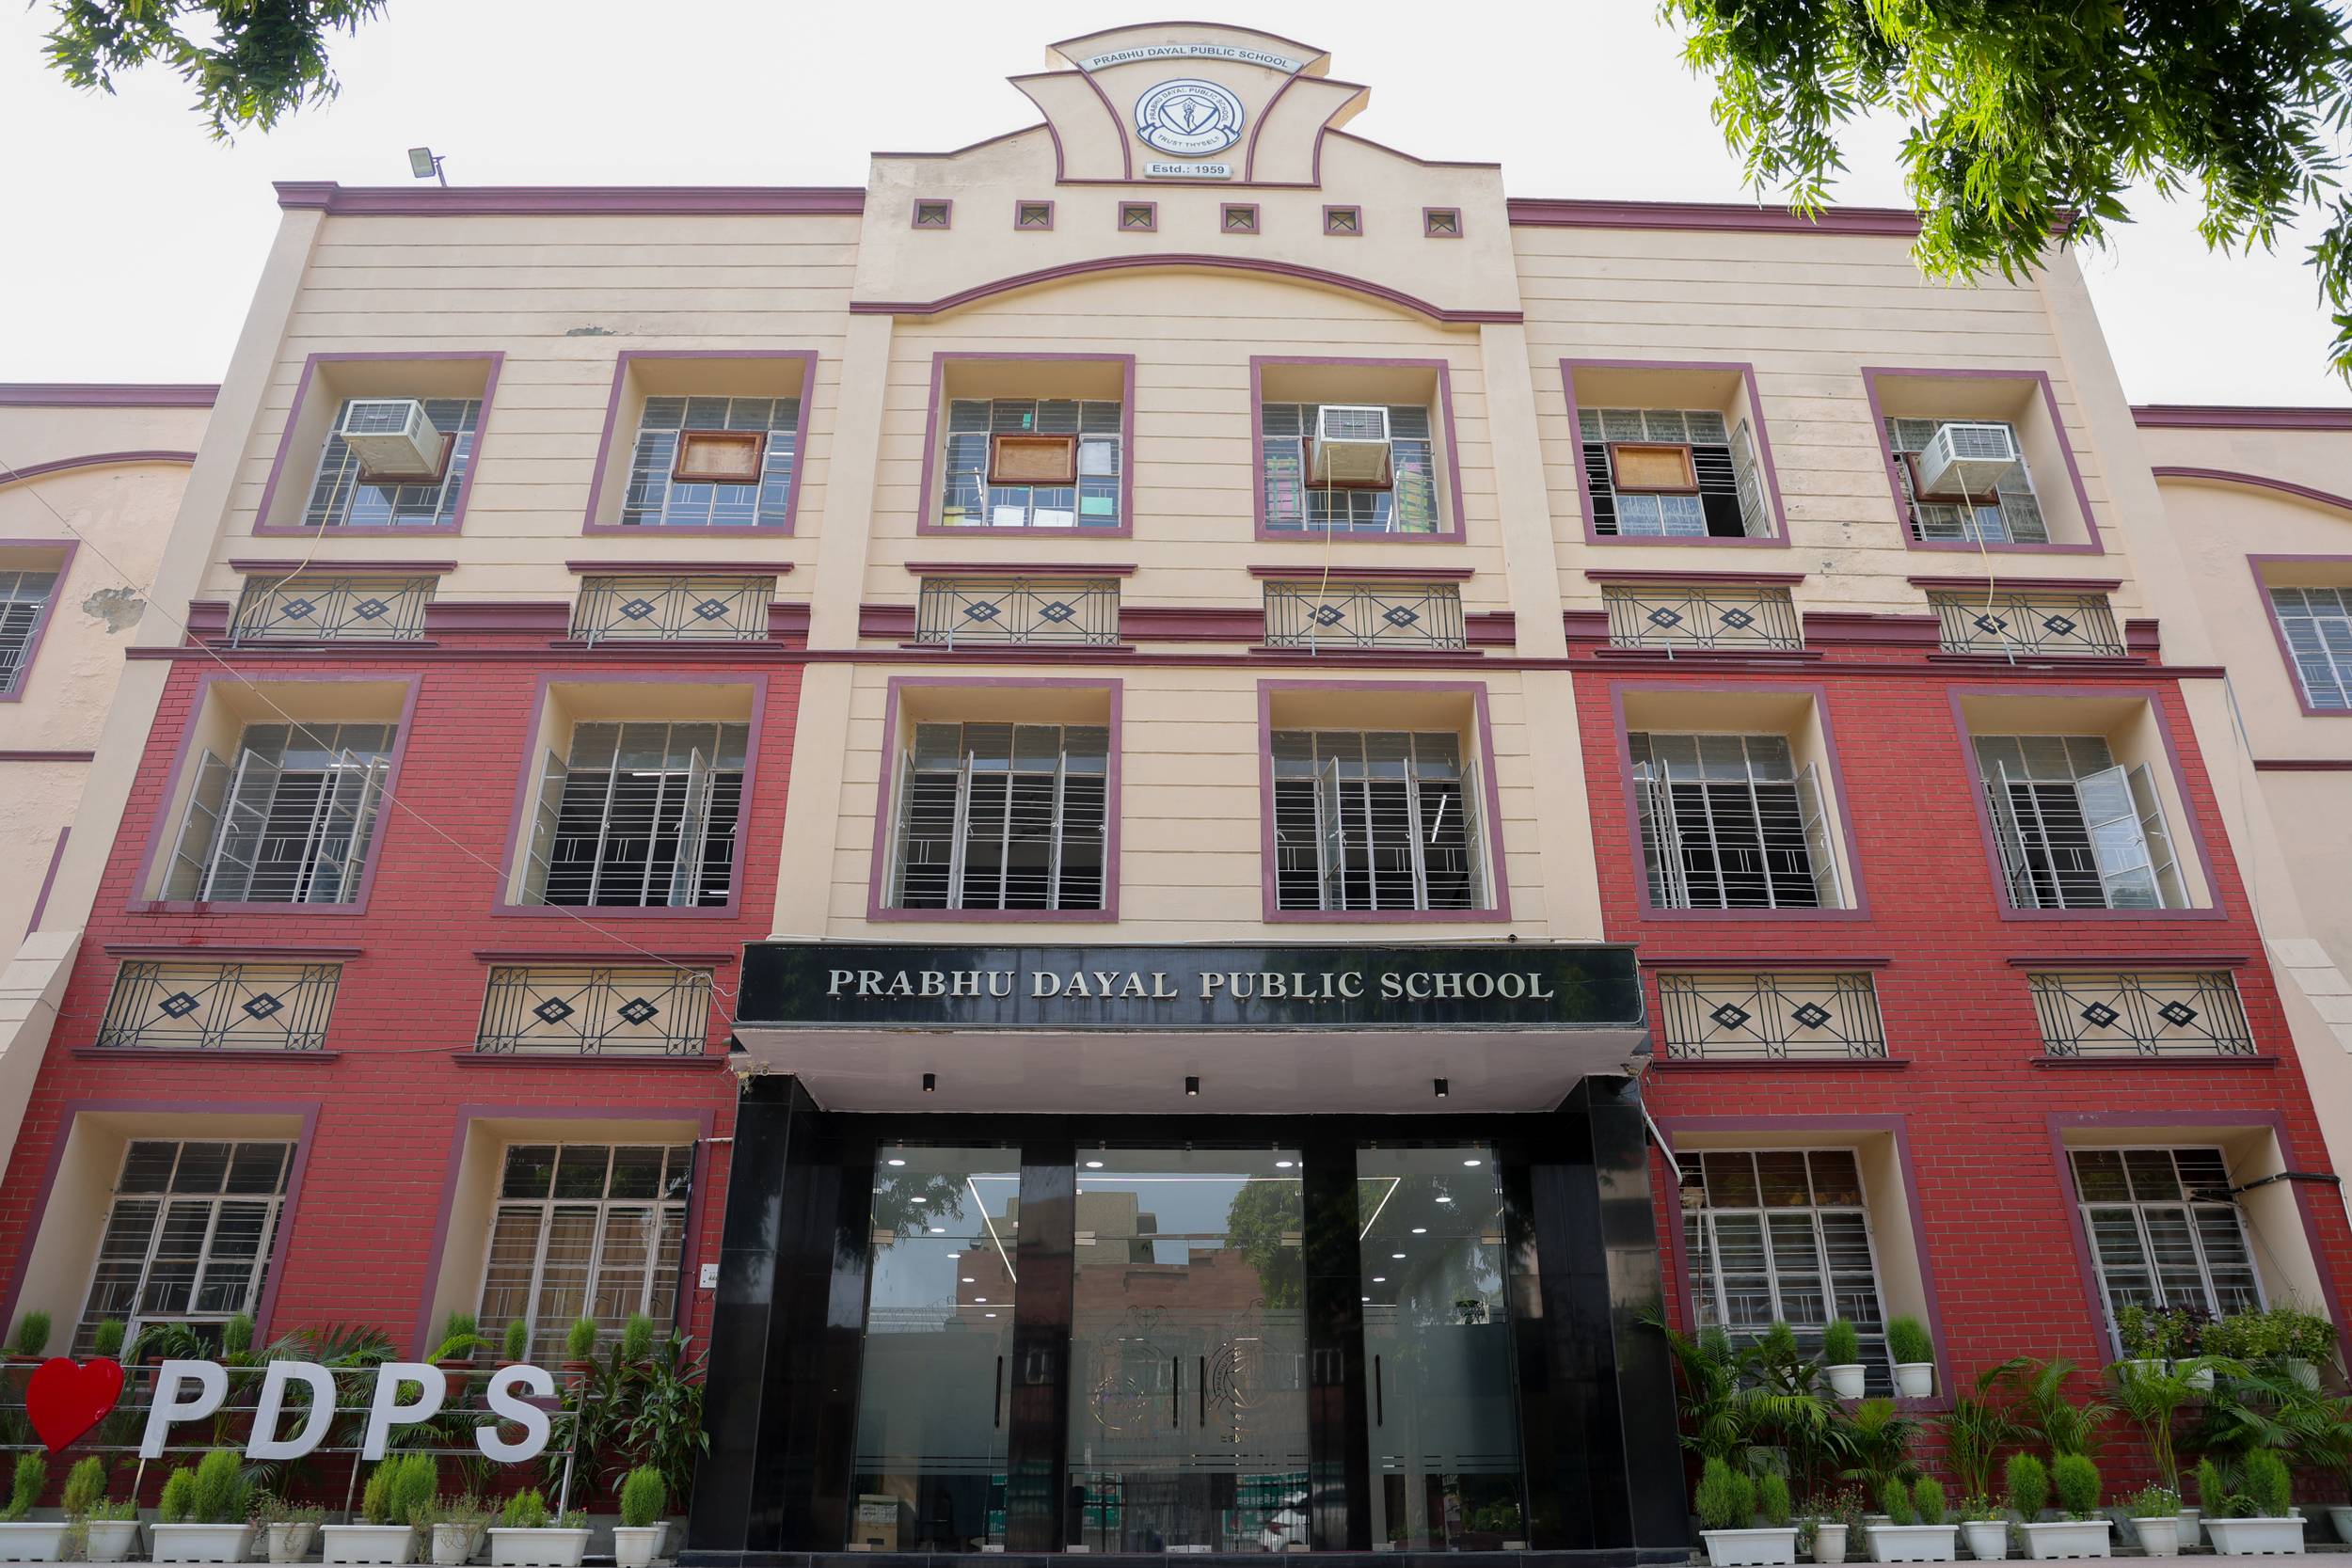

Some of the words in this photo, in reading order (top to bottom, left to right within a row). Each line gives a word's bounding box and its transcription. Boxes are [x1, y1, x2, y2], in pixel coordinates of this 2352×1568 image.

[1093, 50, 1144, 66] PRABHU
[1147, 46, 1187, 56] DAYAL
[1190, 46, 1235, 56] PUBLIC
[1238, 51, 1288, 68] SCHOOL
[1150, 97, 1163, 120] PRABHU
[1162, 87, 1187, 99] DAYAL
[1188, 87, 1217, 100] PUBLIC
[1216, 99, 1229, 122] SCHOOL
[1158, 135, 1183, 148] TRUST
[1185, 135, 1220, 148] THYSELF
[1152, 165, 1190, 174] Estd.:
[1195, 166, 1225, 174] 1959
[826, 970, 1015, 997] PRABHU
[1031, 972, 1179, 998] DAYAL
[1199, 972, 1364, 998] PUBLIC
[1380, 972, 1554, 999] SCHOOL
[138, 1360, 556, 1463] PDPS
